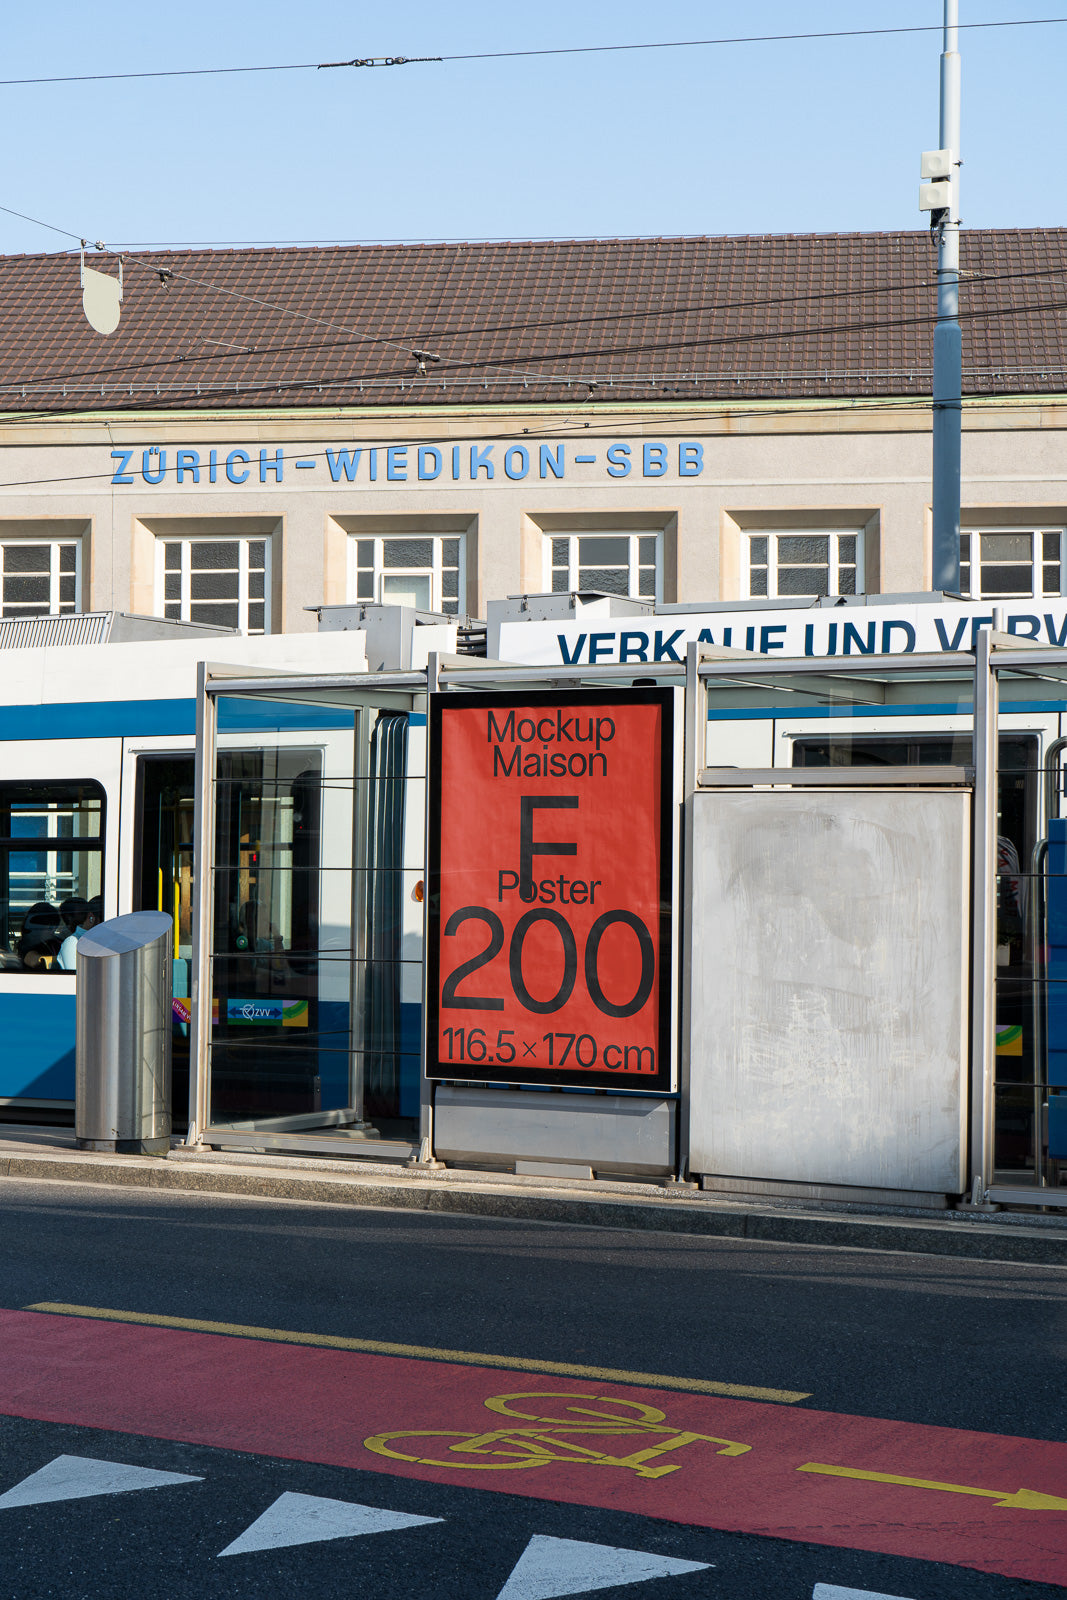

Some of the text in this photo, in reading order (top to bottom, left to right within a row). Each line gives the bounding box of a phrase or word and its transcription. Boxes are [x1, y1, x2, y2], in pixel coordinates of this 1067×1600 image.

[804, 620, 916, 657] UND
[487, 709, 616, 752] Mockup
[493, 744, 608, 778] Maison
[519, 795, 580, 900] F
[498, 869, 602, 905] Poster
[441, 905, 655, 1018] 200
[255, 1009, 271, 1017] ZVV
[442, 1027, 517, 1063] 116.5
[542, 1032, 598, 1068] 170
[602, 1044, 655, 1072] cm
